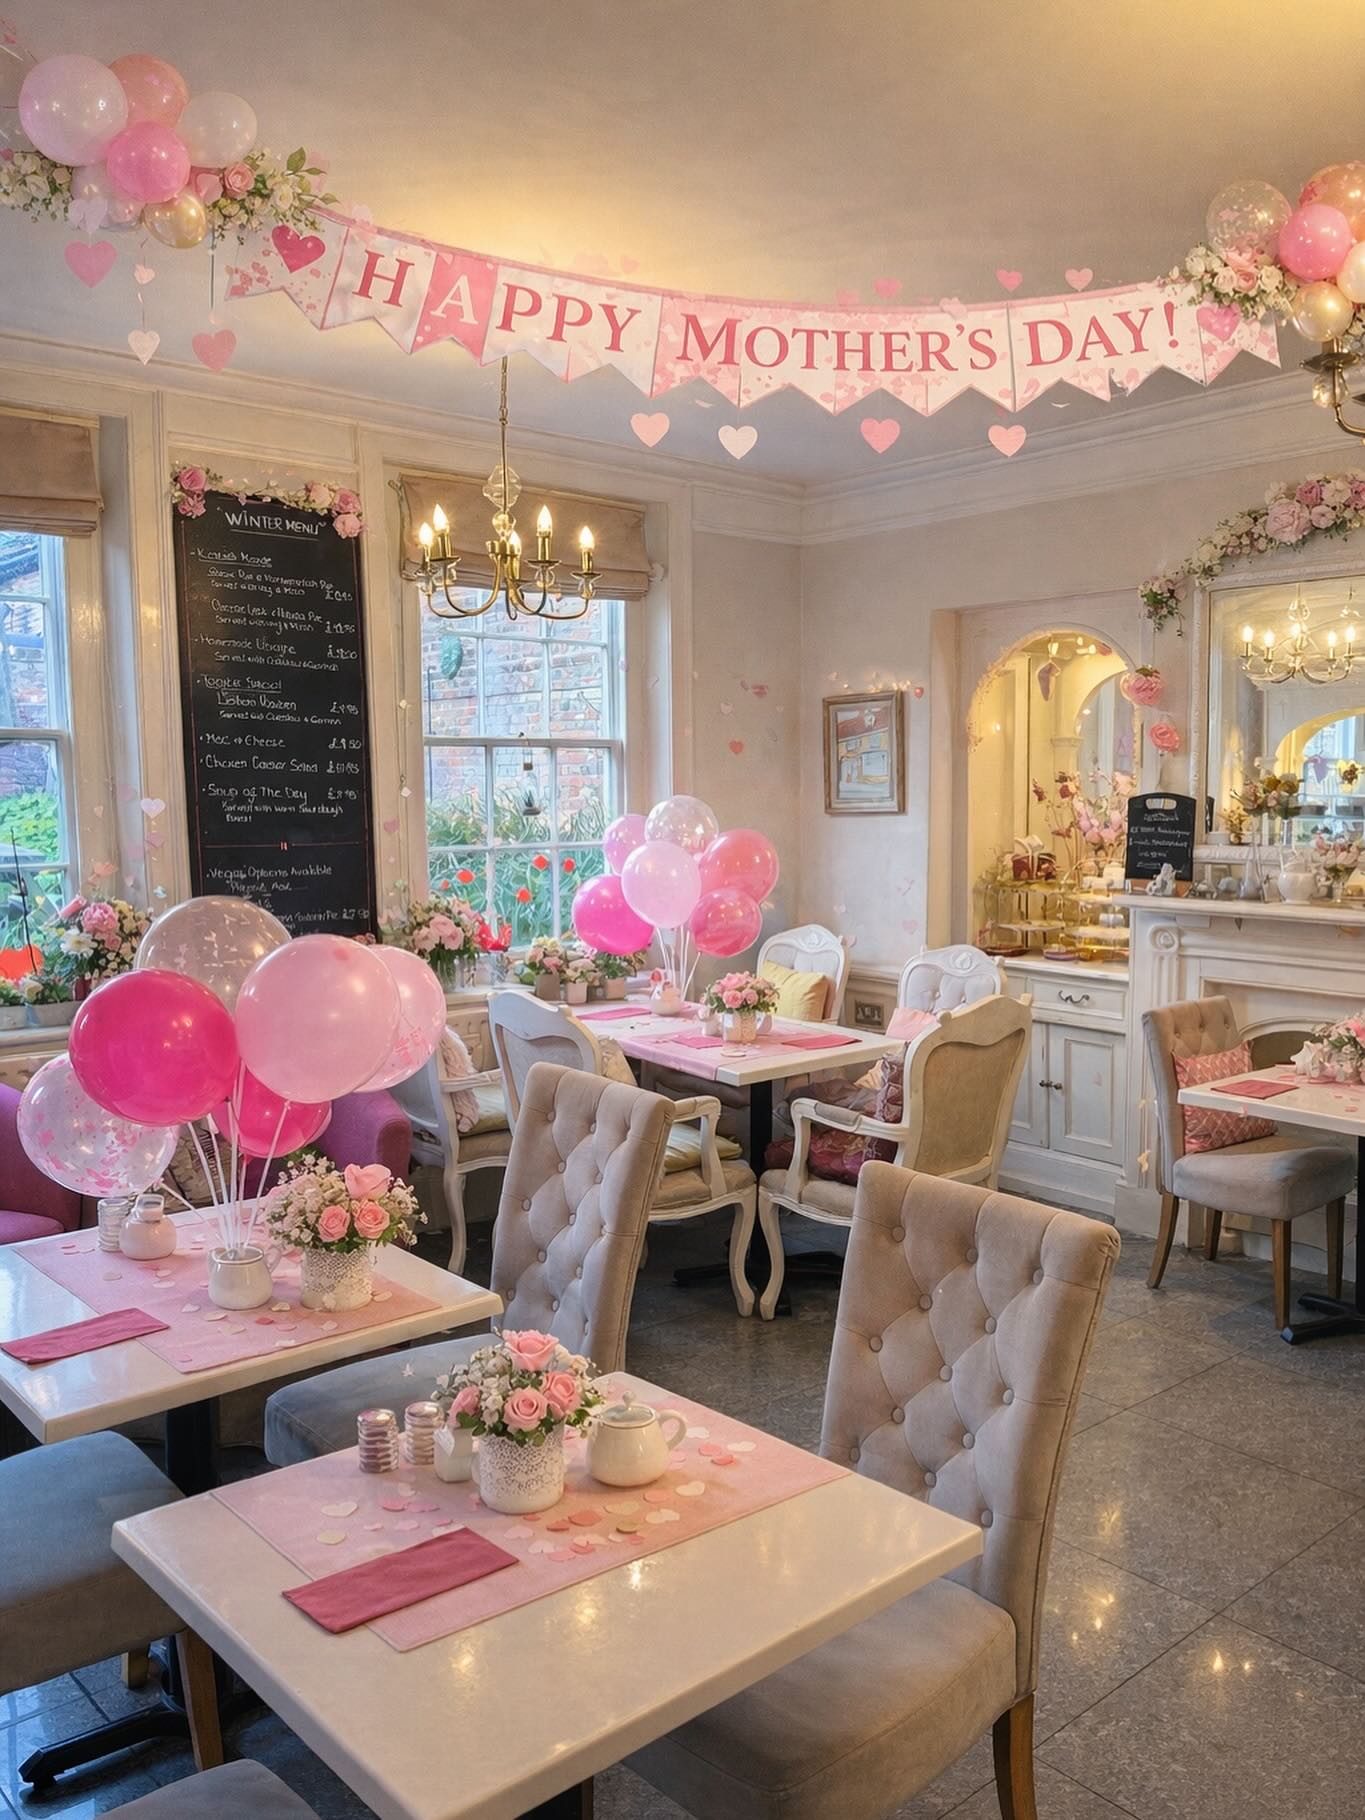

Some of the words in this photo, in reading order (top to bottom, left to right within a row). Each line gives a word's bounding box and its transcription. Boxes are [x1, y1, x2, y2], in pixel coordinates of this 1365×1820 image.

[352, 250, 642, 352] HAPPY
[676, 312, 998, 372] MOTHER'S
[1022, 302, 1180, 366] DAY!
[225, 510, 283, 531] WINTER
[286, 519, 319, 535] MENU
[208, 783, 238, 800] Soup
